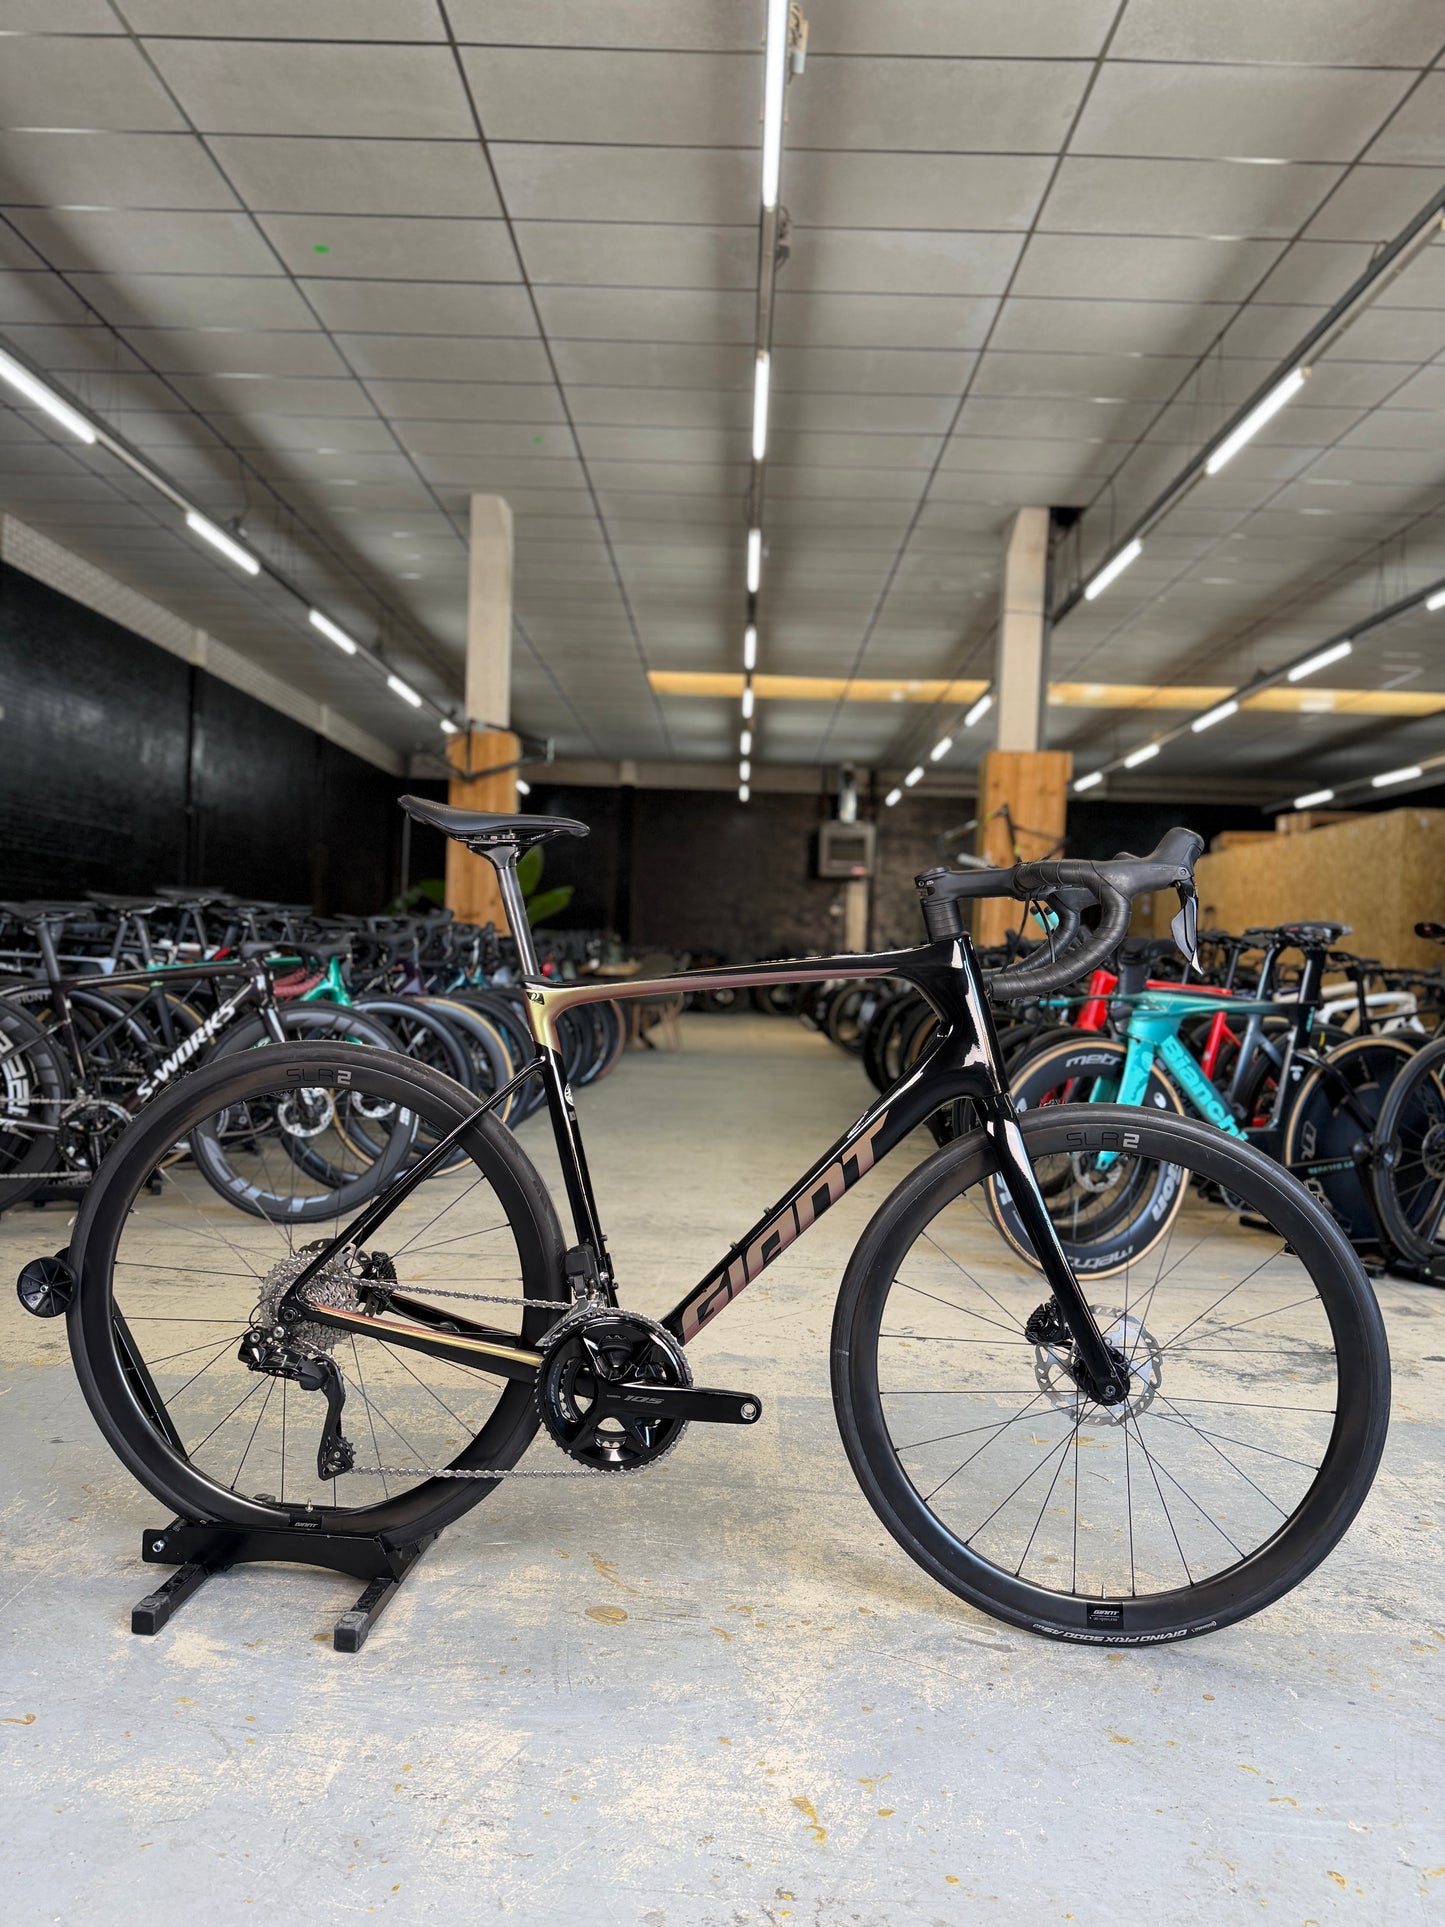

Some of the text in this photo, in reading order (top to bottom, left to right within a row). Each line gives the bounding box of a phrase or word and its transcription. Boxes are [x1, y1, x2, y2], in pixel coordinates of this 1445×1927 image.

[136, 999, 235, 1103] S-WORKS
[682, 1110, 889, 1344] GIANT
[624, 1394, 665, 1405] 105
[1063, 1632, 1105, 1643] 5000
[1139, 1628, 1188, 1642] GRAND
